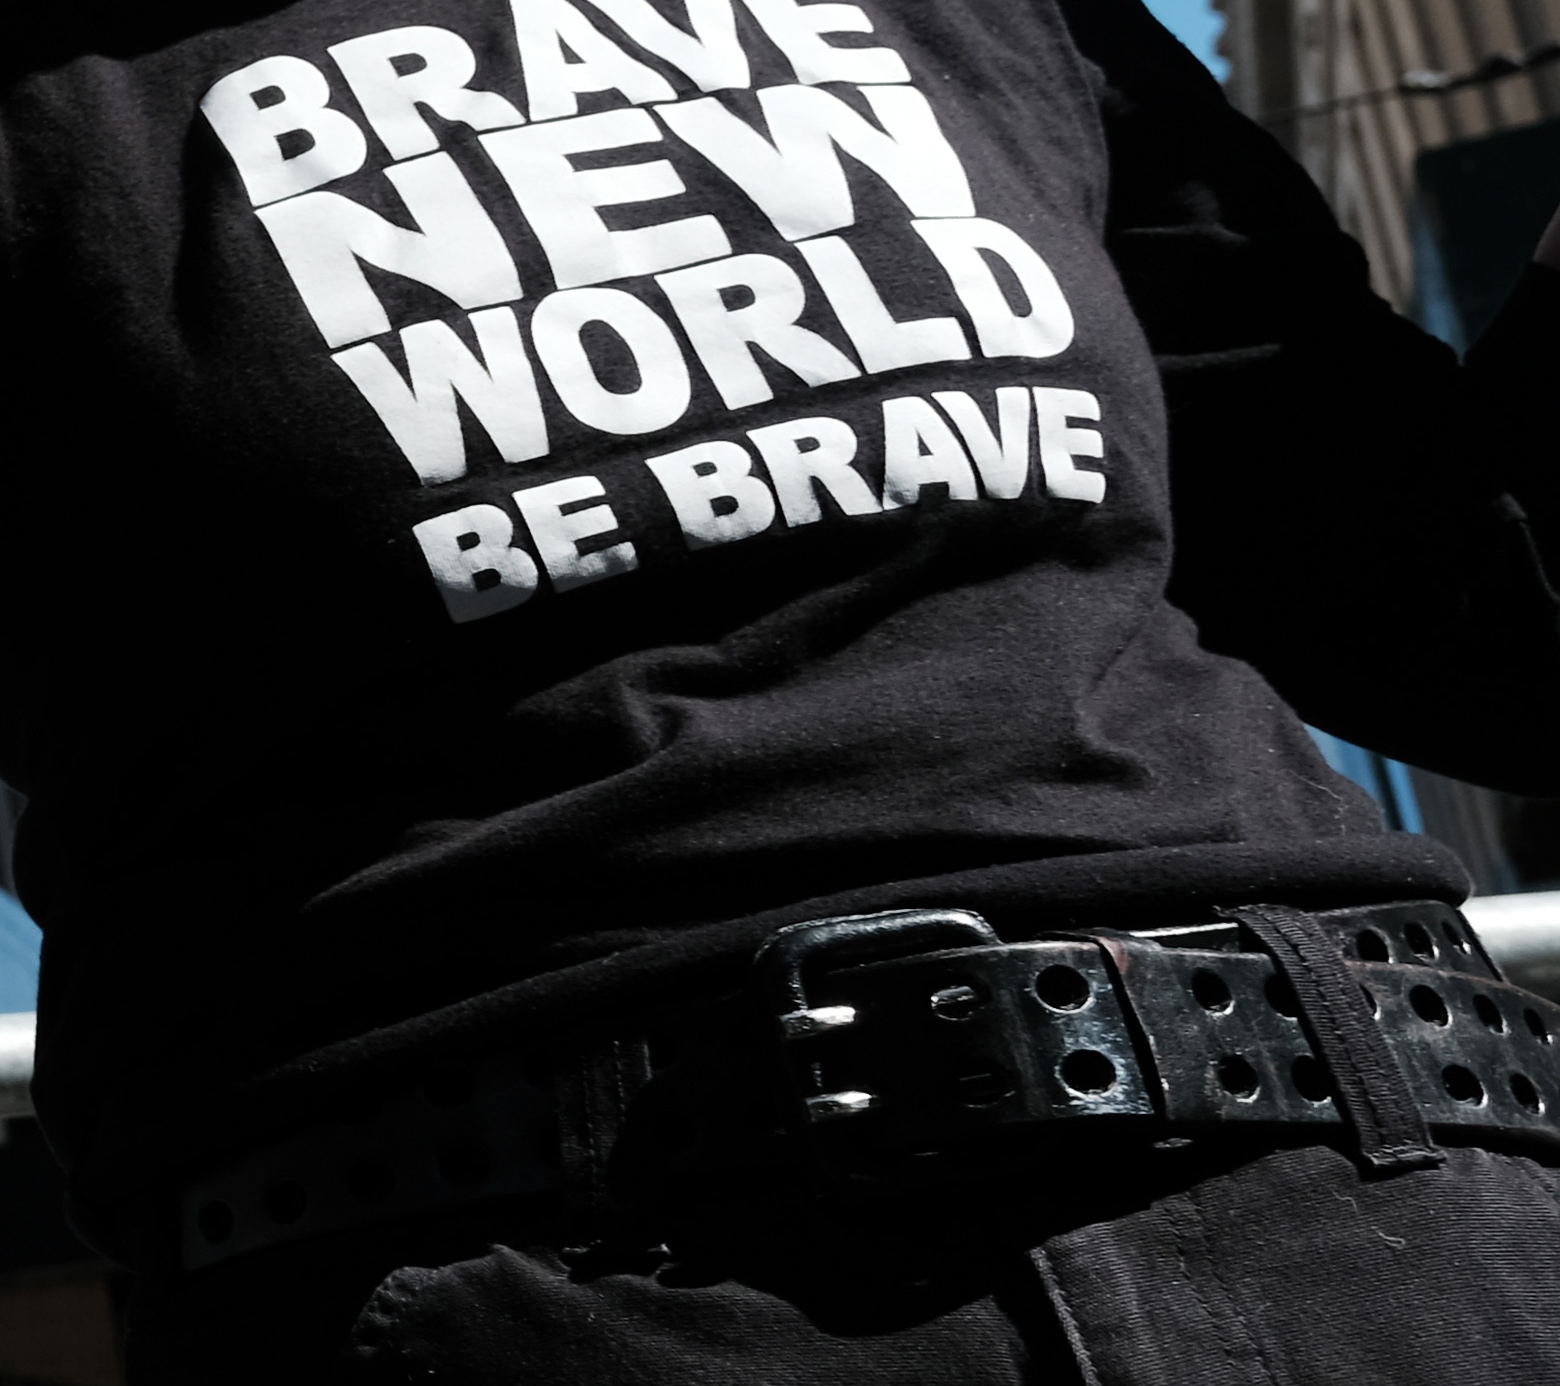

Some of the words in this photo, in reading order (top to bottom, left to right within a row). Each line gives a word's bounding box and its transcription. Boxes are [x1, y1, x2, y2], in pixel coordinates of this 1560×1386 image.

[253, 84, 978, 349] NEW
[330, 216, 1076, 486] WORLD
[412, 476, 639, 624] BE
[645, 386, 1107, 551] BRAVE
